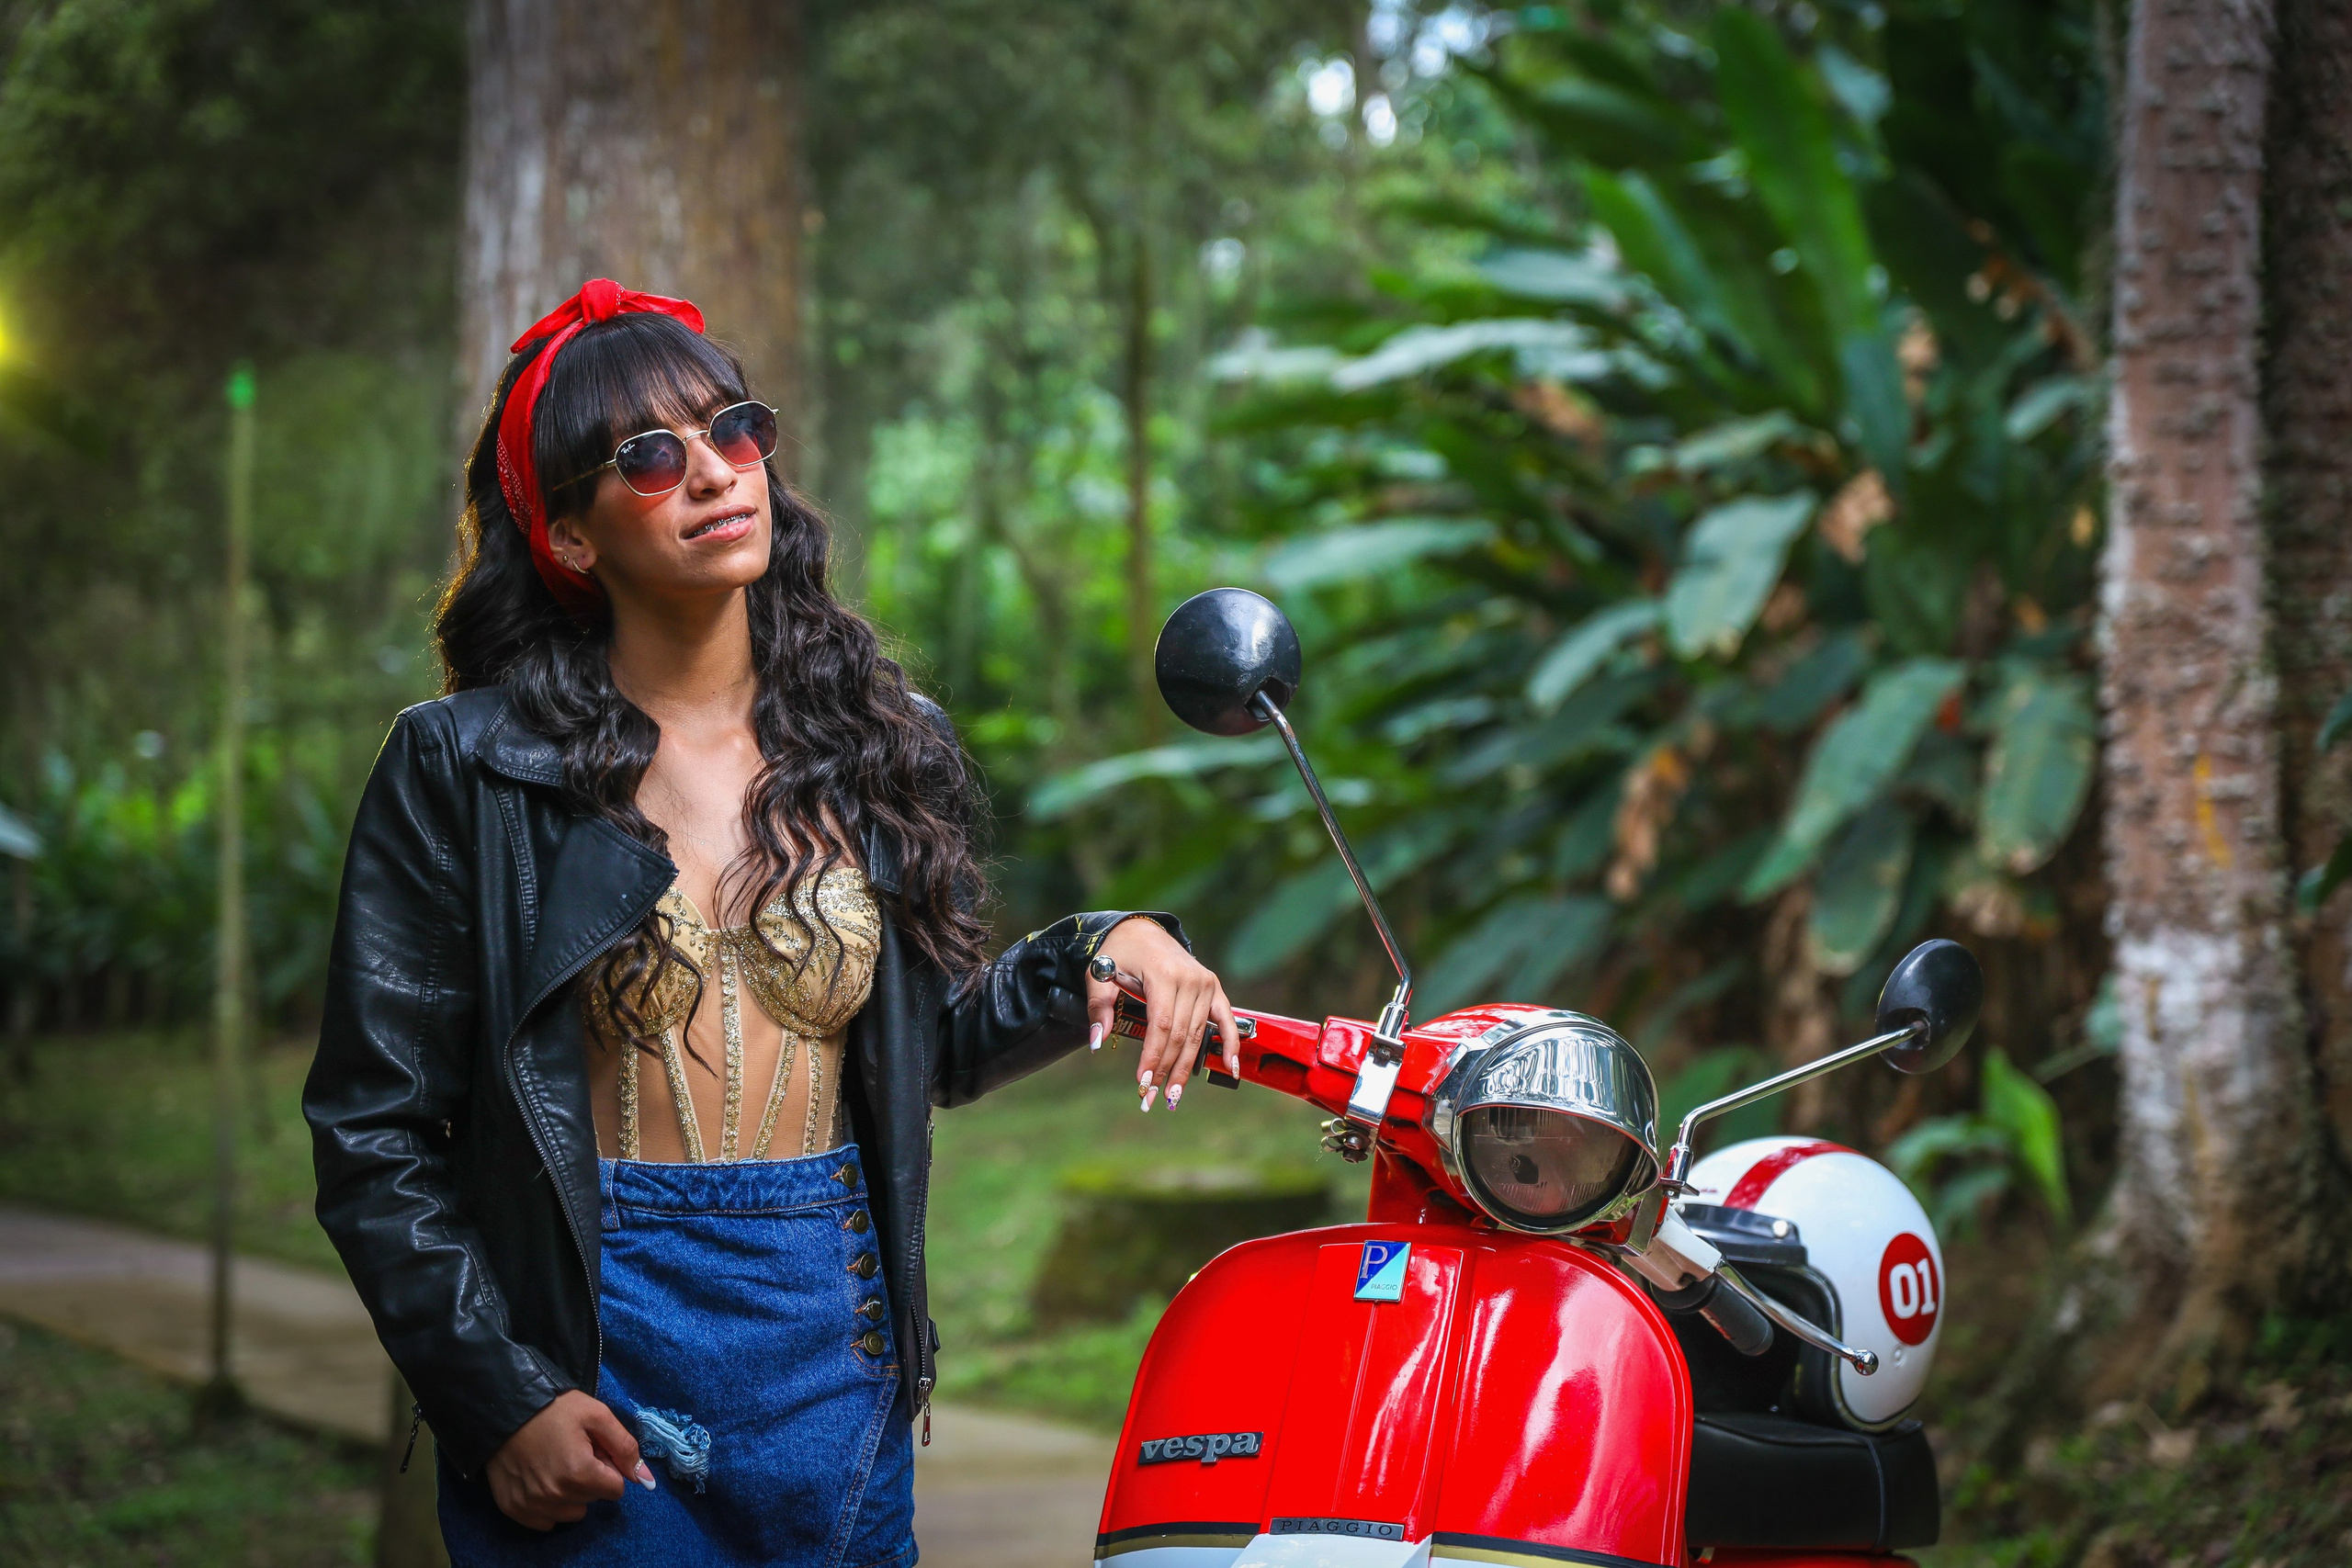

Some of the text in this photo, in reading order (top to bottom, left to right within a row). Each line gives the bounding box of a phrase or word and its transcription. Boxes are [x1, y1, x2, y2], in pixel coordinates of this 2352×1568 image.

[1360, 1245, 1388, 1279] P
[1889, 1258, 1936, 1319] 01
[1140, 1431, 1259, 1463] vespa
[1280, 1519, 1393, 1536] PIAGGIO
